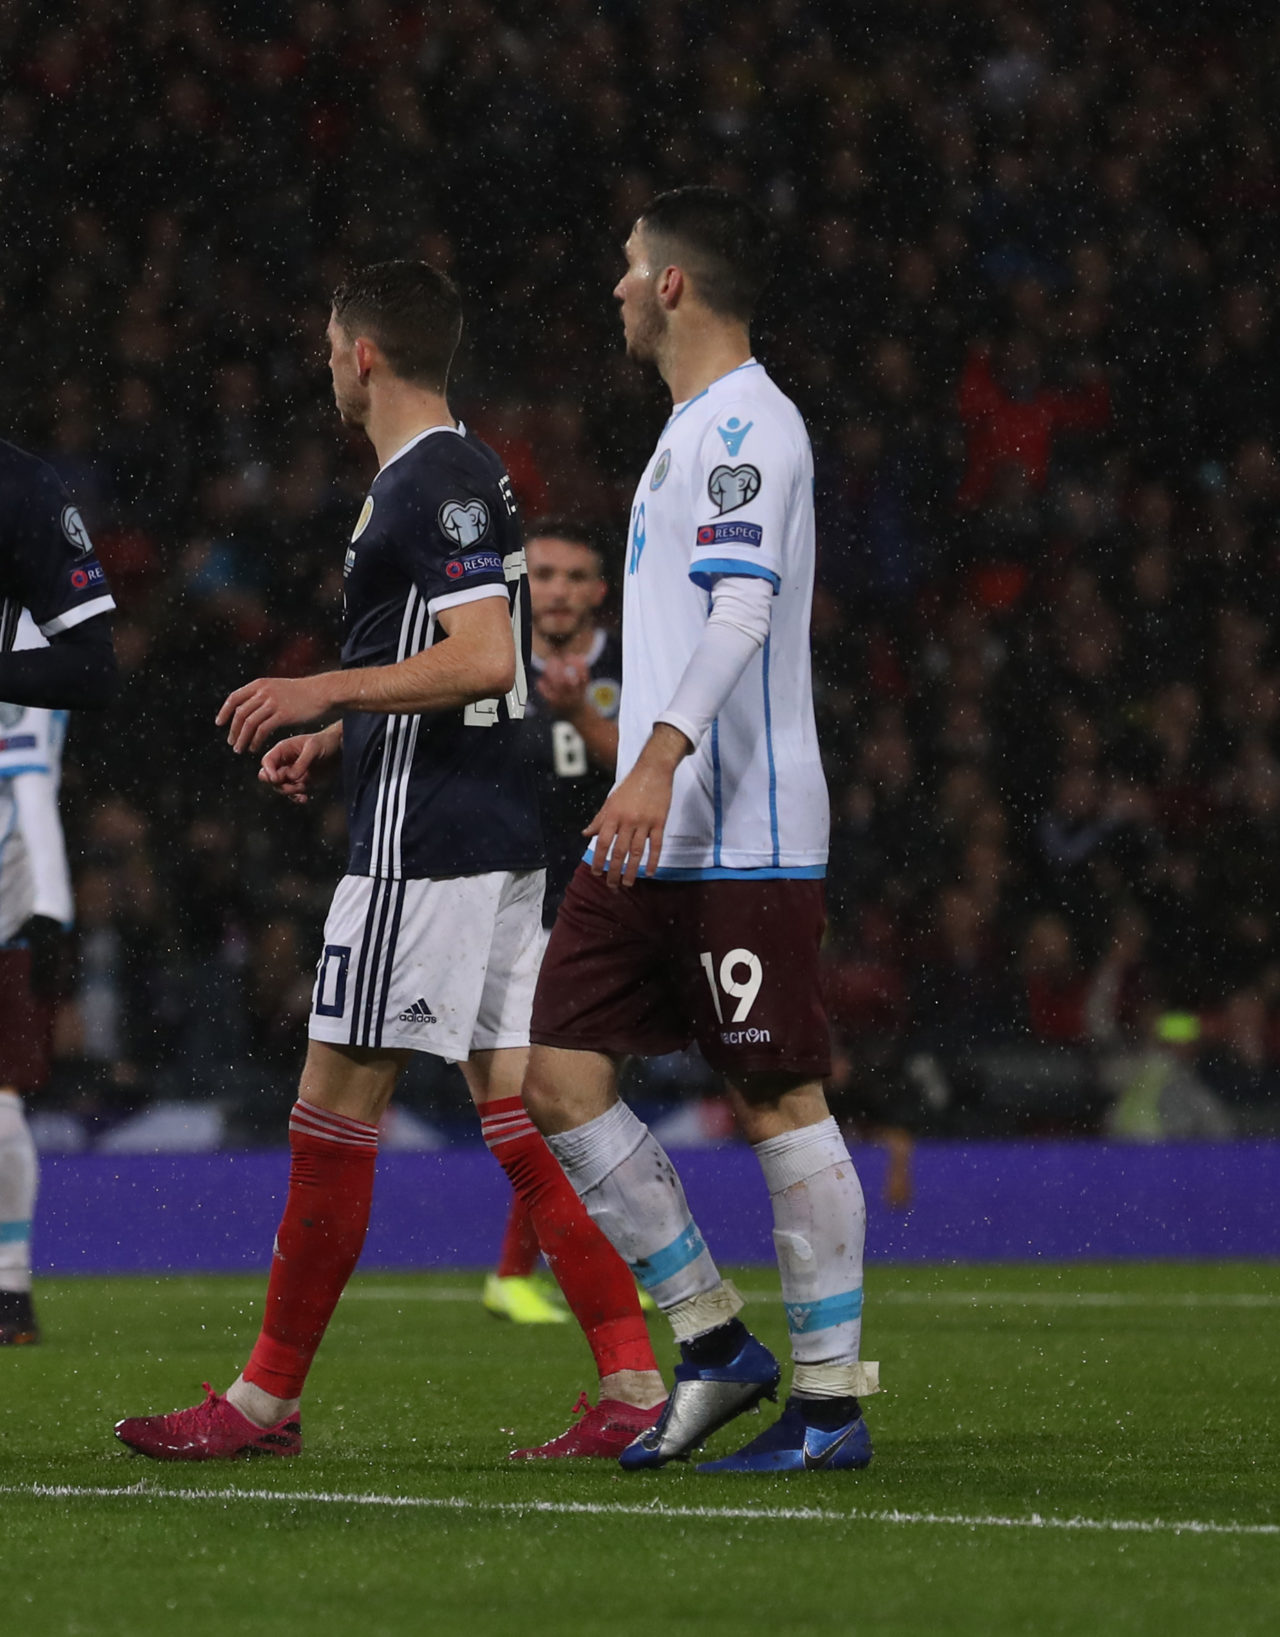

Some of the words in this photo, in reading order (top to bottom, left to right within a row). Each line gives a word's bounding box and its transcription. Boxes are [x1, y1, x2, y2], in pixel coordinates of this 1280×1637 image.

[715, 526, 763, 541] RESPECT
[552, 720, 587, 777] 8
[700, 948, 763, 1024] 19
[399, 1012, 437, 1024] adidas
[720, 1027, 771, 1044] acron
